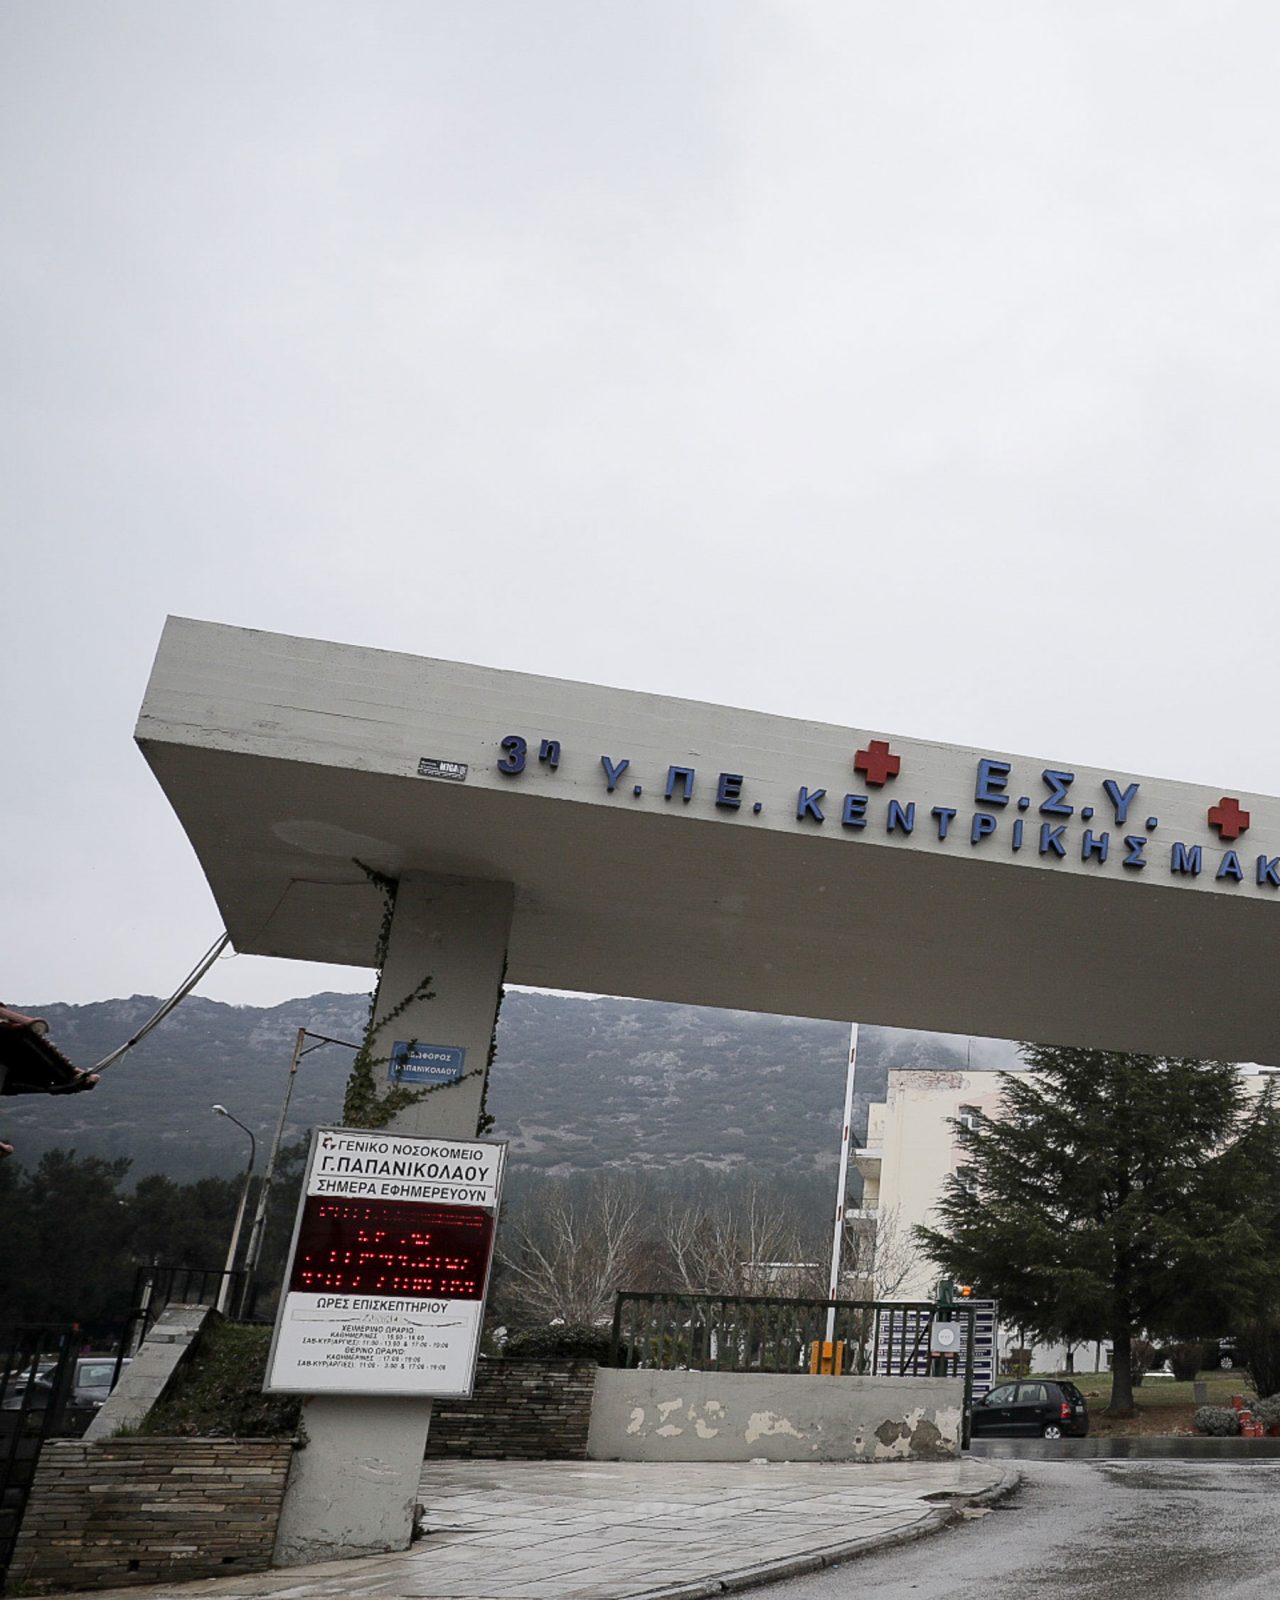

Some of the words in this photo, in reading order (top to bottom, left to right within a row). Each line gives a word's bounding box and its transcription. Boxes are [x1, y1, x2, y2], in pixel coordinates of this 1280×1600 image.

[497, 735, 561, 775] 3η
[601, 755, 762, 813] Υ.ΠΕ.
[796, 786, 1147, 868] ΚΕΝΤΡΙΚΗΣ
[974, 758, 1158, 830] Ε.Σ.Υ.
[338, 1140, 389, 1154] ΓΕΝΙΚΟ
[392, 1144, 484, 1161] ΝΟΣΟΚΟΜΕΙΟ
[321, 1156, 490, 1182] Γ.ΠΑΠΑΝΙΚΟΛΑΟΥ
[317, 1179, 377, 1195] ΣΗΜΕΡΑ
[381, 1183, 487, 1202] ΕΦΗΜΕΡΕΥΟΥΝ
[316, 1297, 350, 1310] ΩΡΕΣ
[352, 1299, 449, 1314] ΕΠΙΣΚΕΠΤΗΡΙΟΥ
[342, 1324, 384, 1333] ΧΕΙΜΕΡΙΝΟ
